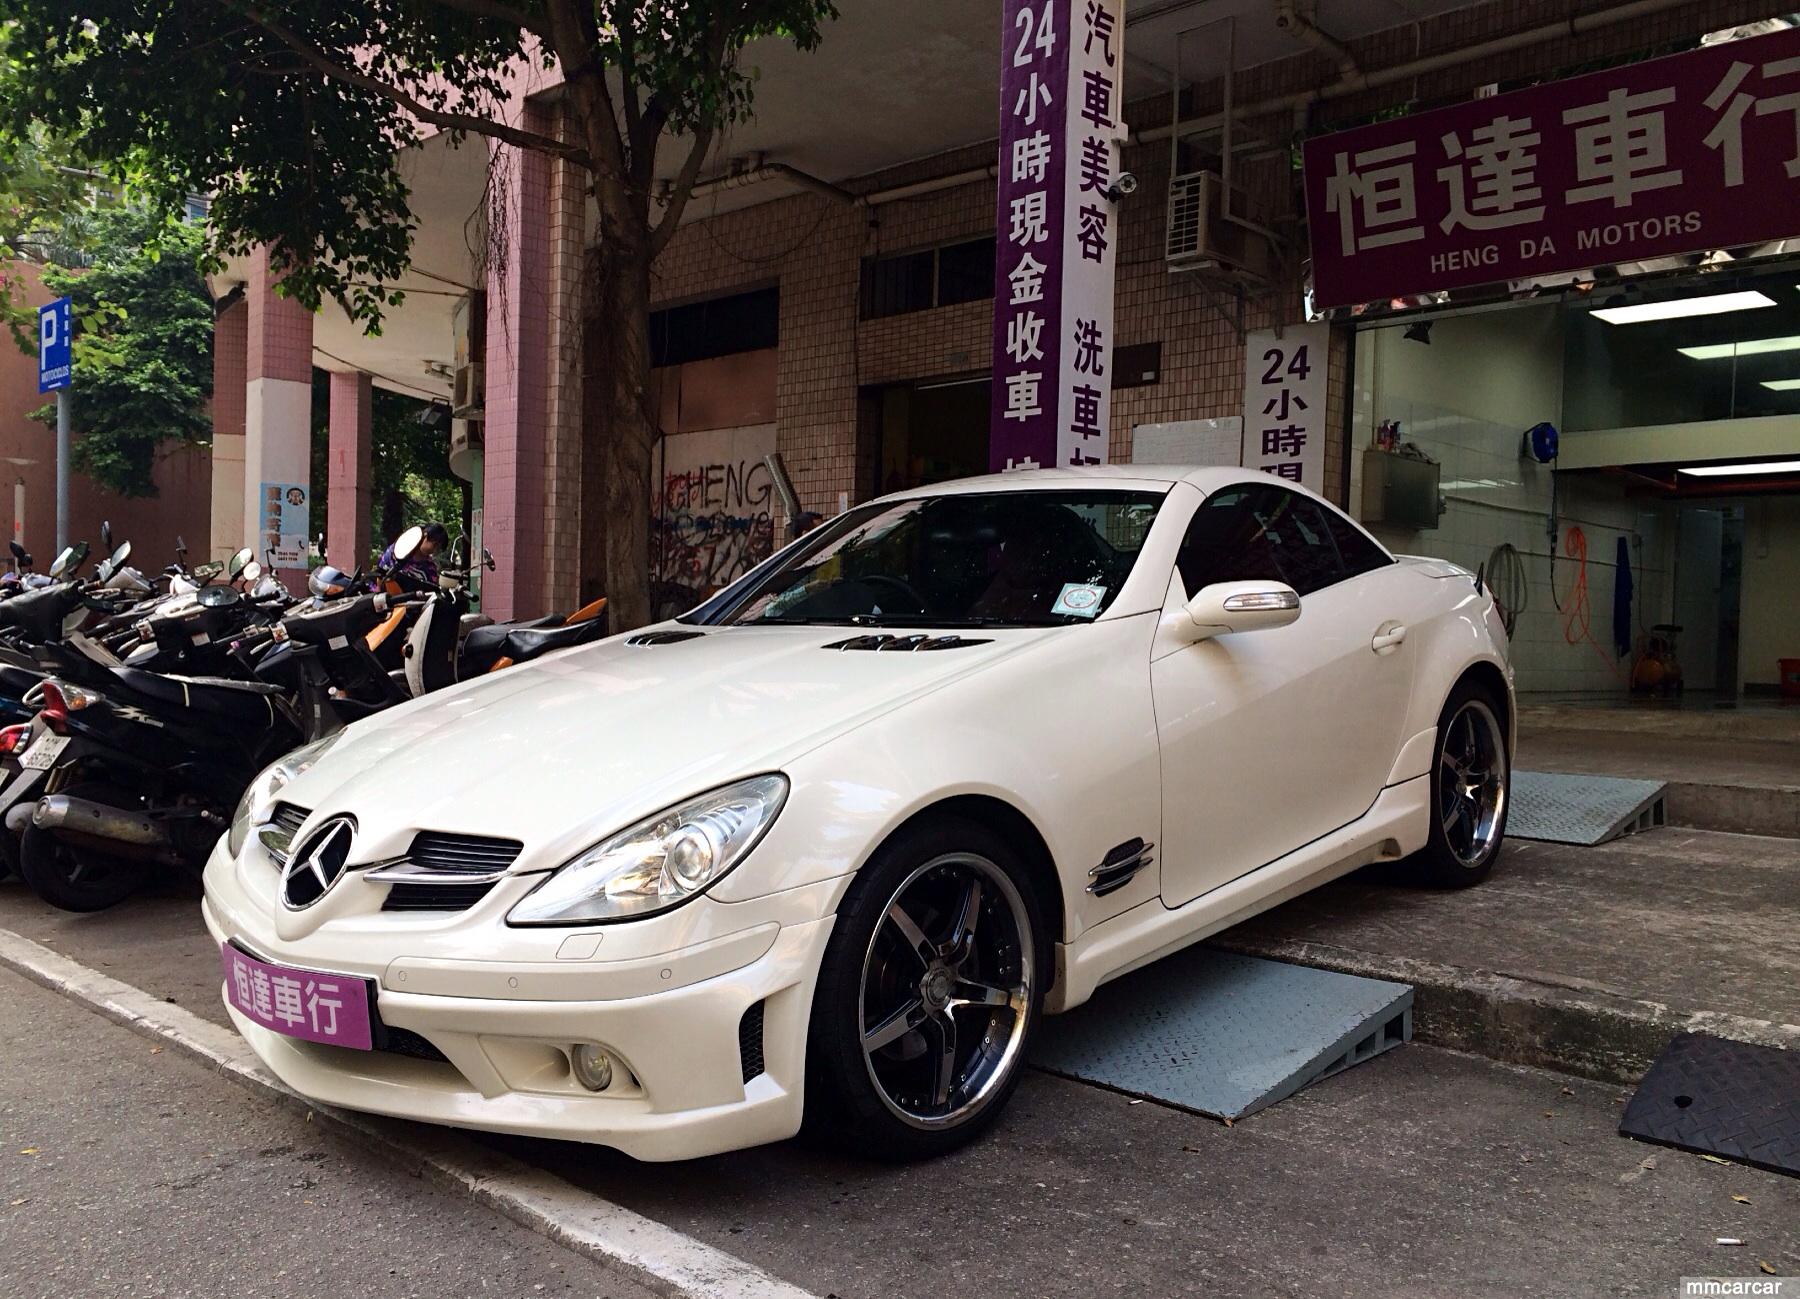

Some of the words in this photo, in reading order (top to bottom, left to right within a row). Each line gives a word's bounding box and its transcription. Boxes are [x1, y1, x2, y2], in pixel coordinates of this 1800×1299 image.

[1076, 0, 1115, 264] 汽車美容
[1326, 57, 1800, 257] 恒達車行
[1004, 0, 1056, 422] 24小時現金收車
[1430, 244, 1500, 274] HENG
[1519, 236, 1557, 260] DA
[1576, 210, 1703, 251] MOTORS
[41, 310, 57, 370] P
[233, 956, 343, 1035] 恒達車行
